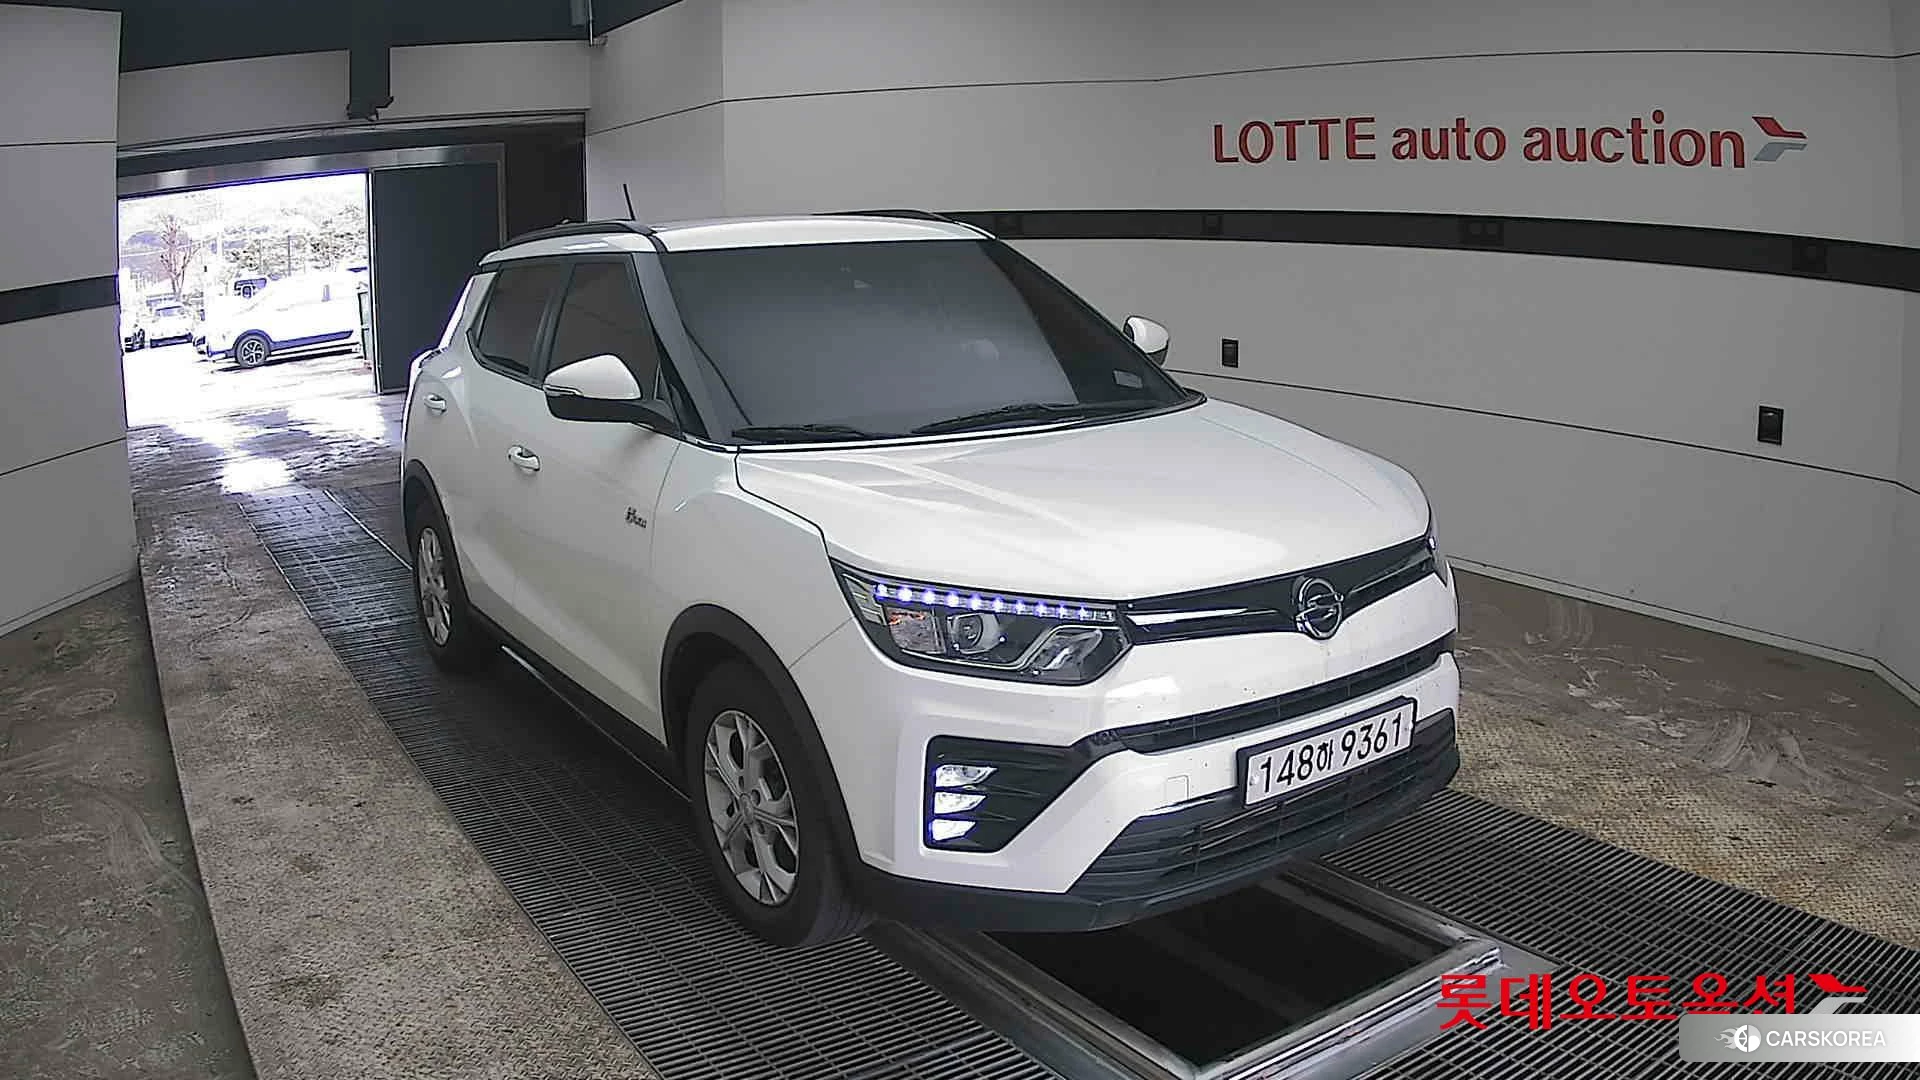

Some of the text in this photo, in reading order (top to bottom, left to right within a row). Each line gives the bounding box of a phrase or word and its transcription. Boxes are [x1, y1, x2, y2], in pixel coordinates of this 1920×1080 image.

[1212, 109, 1746, 169] LOTTE auto auction
[1259, 712, 1402, 793] 148하 9361
